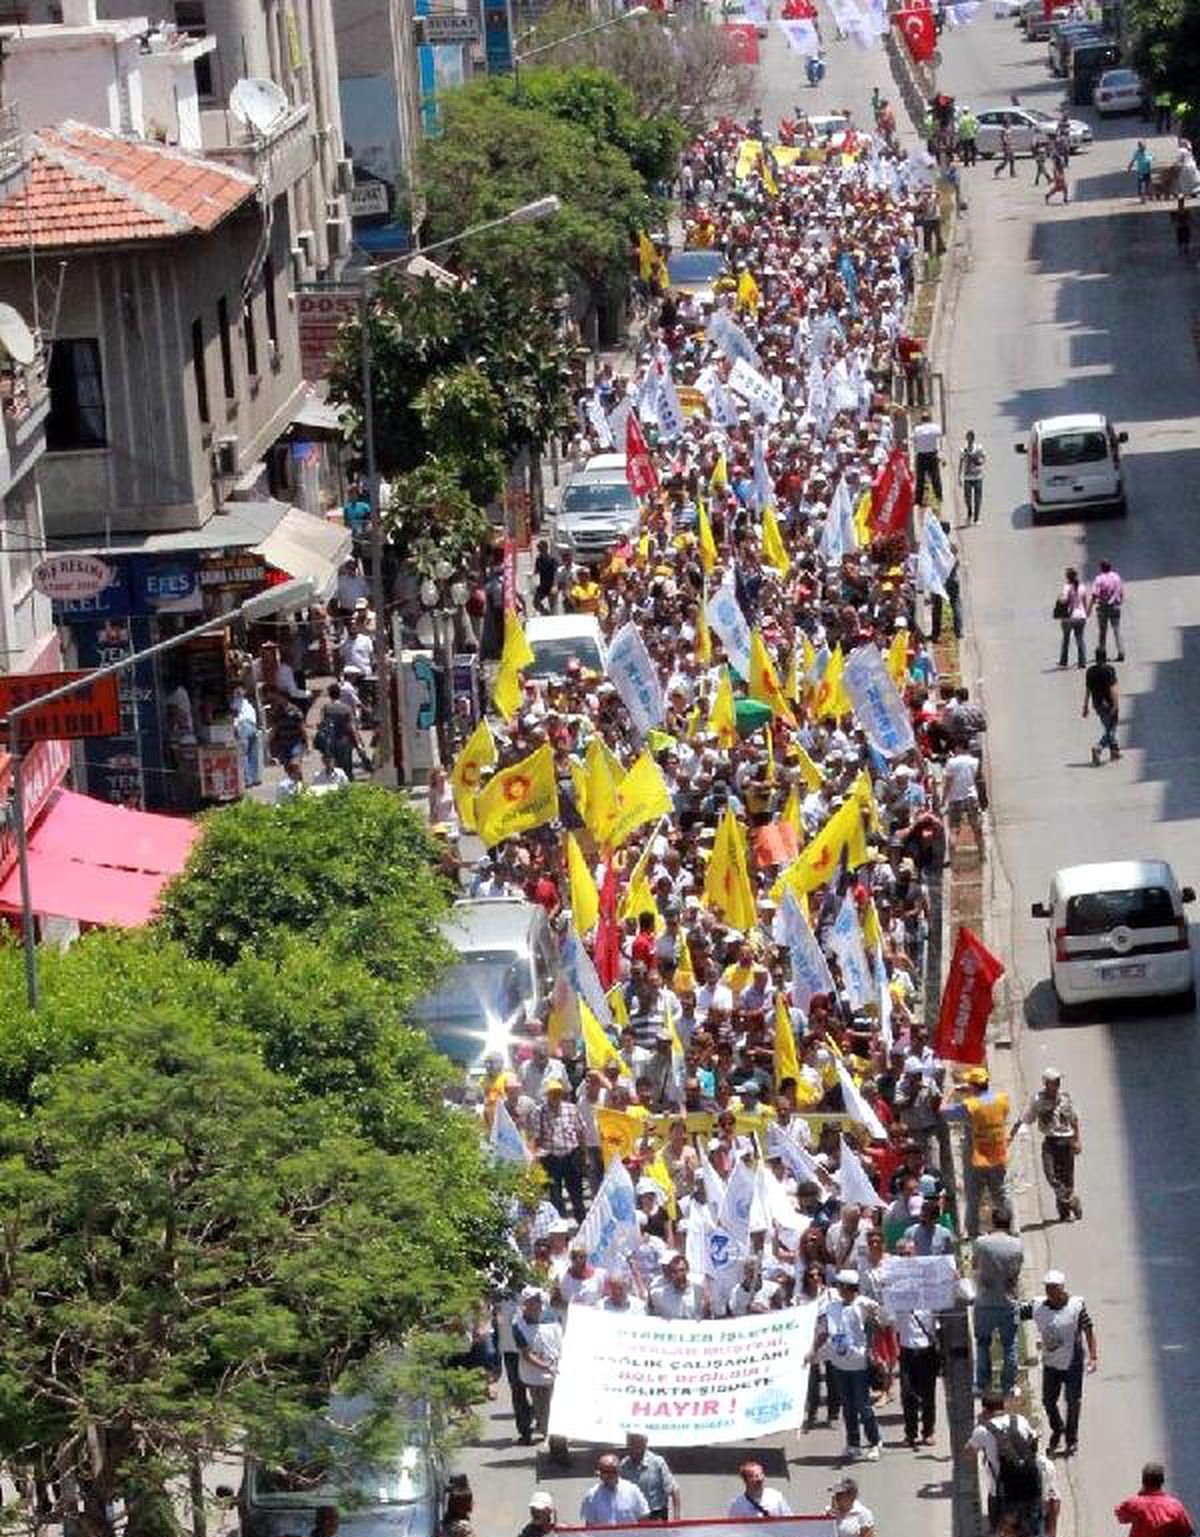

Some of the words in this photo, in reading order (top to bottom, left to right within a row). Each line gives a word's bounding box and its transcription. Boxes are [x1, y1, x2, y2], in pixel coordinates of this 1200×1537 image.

[147, 575, 190, 593] EFES
[630, 1400, 720, 1418] HAYIR
[728, 1397, 738, 1415] !
